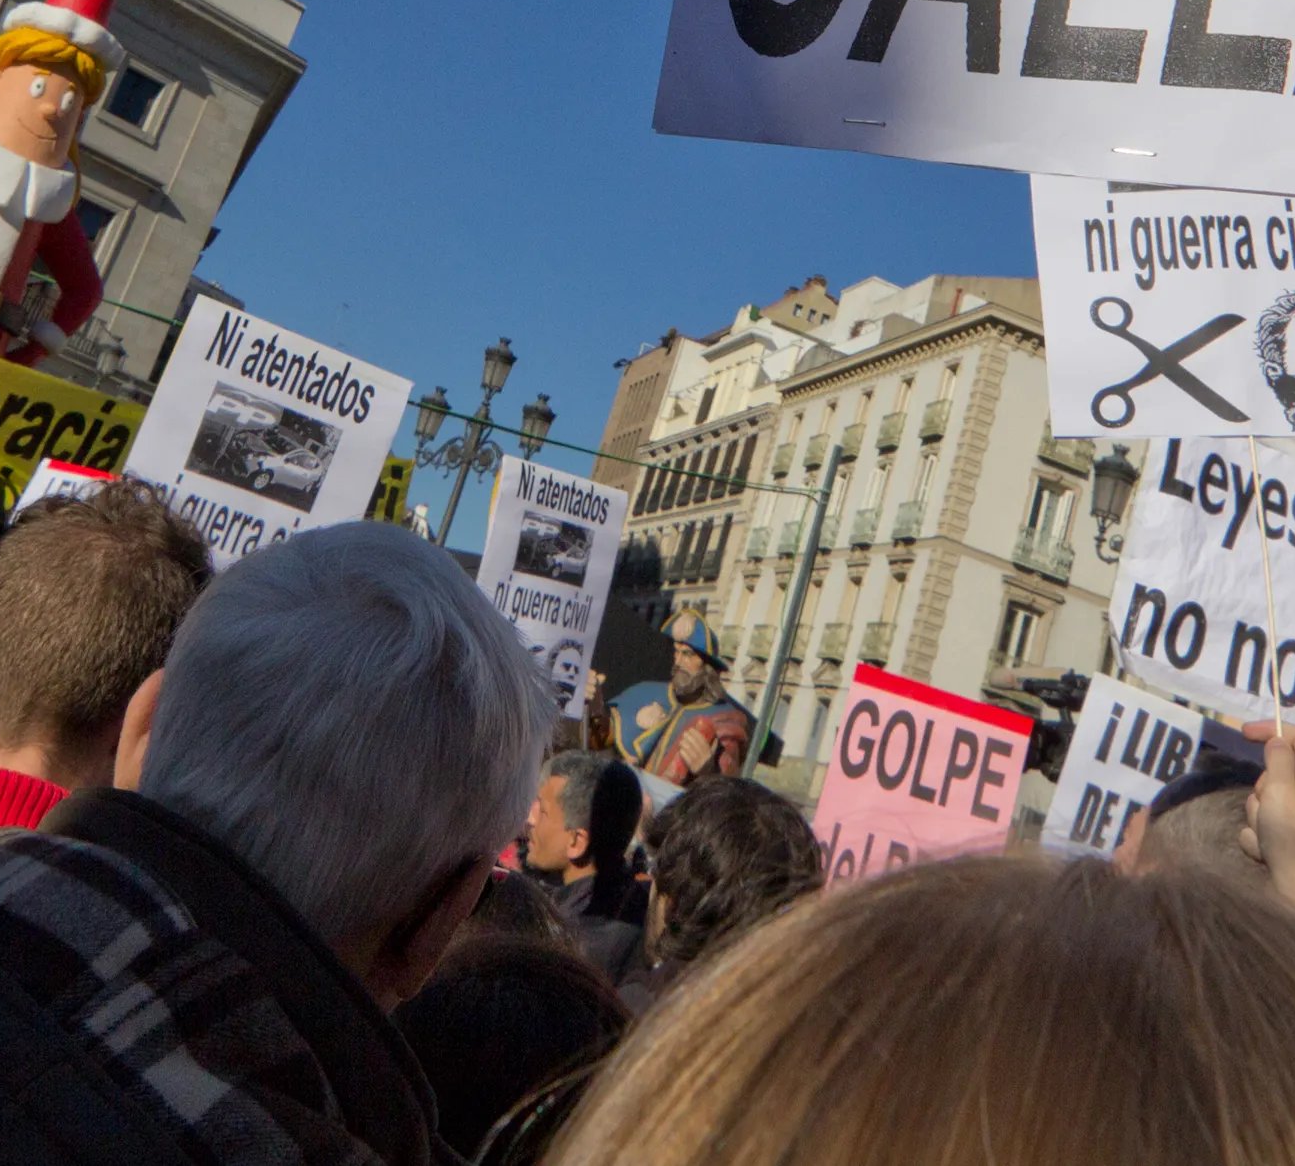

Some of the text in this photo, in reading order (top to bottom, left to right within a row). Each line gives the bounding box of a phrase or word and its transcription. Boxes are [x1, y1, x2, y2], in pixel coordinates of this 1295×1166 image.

[1084, 199, 1119, 272] ni
[1130, 214, 1257, 291] guerra
[206, 310, 376, 425] Ni atentados
[516, 461, 610, 526] Ni atentados
[493, 573, 594, 634] ni guerra civil
[1120, 582, 1207, 671] no
[838, 697, 1015, 824] GOLPE
[1068, 781, 1121, 850] DE
